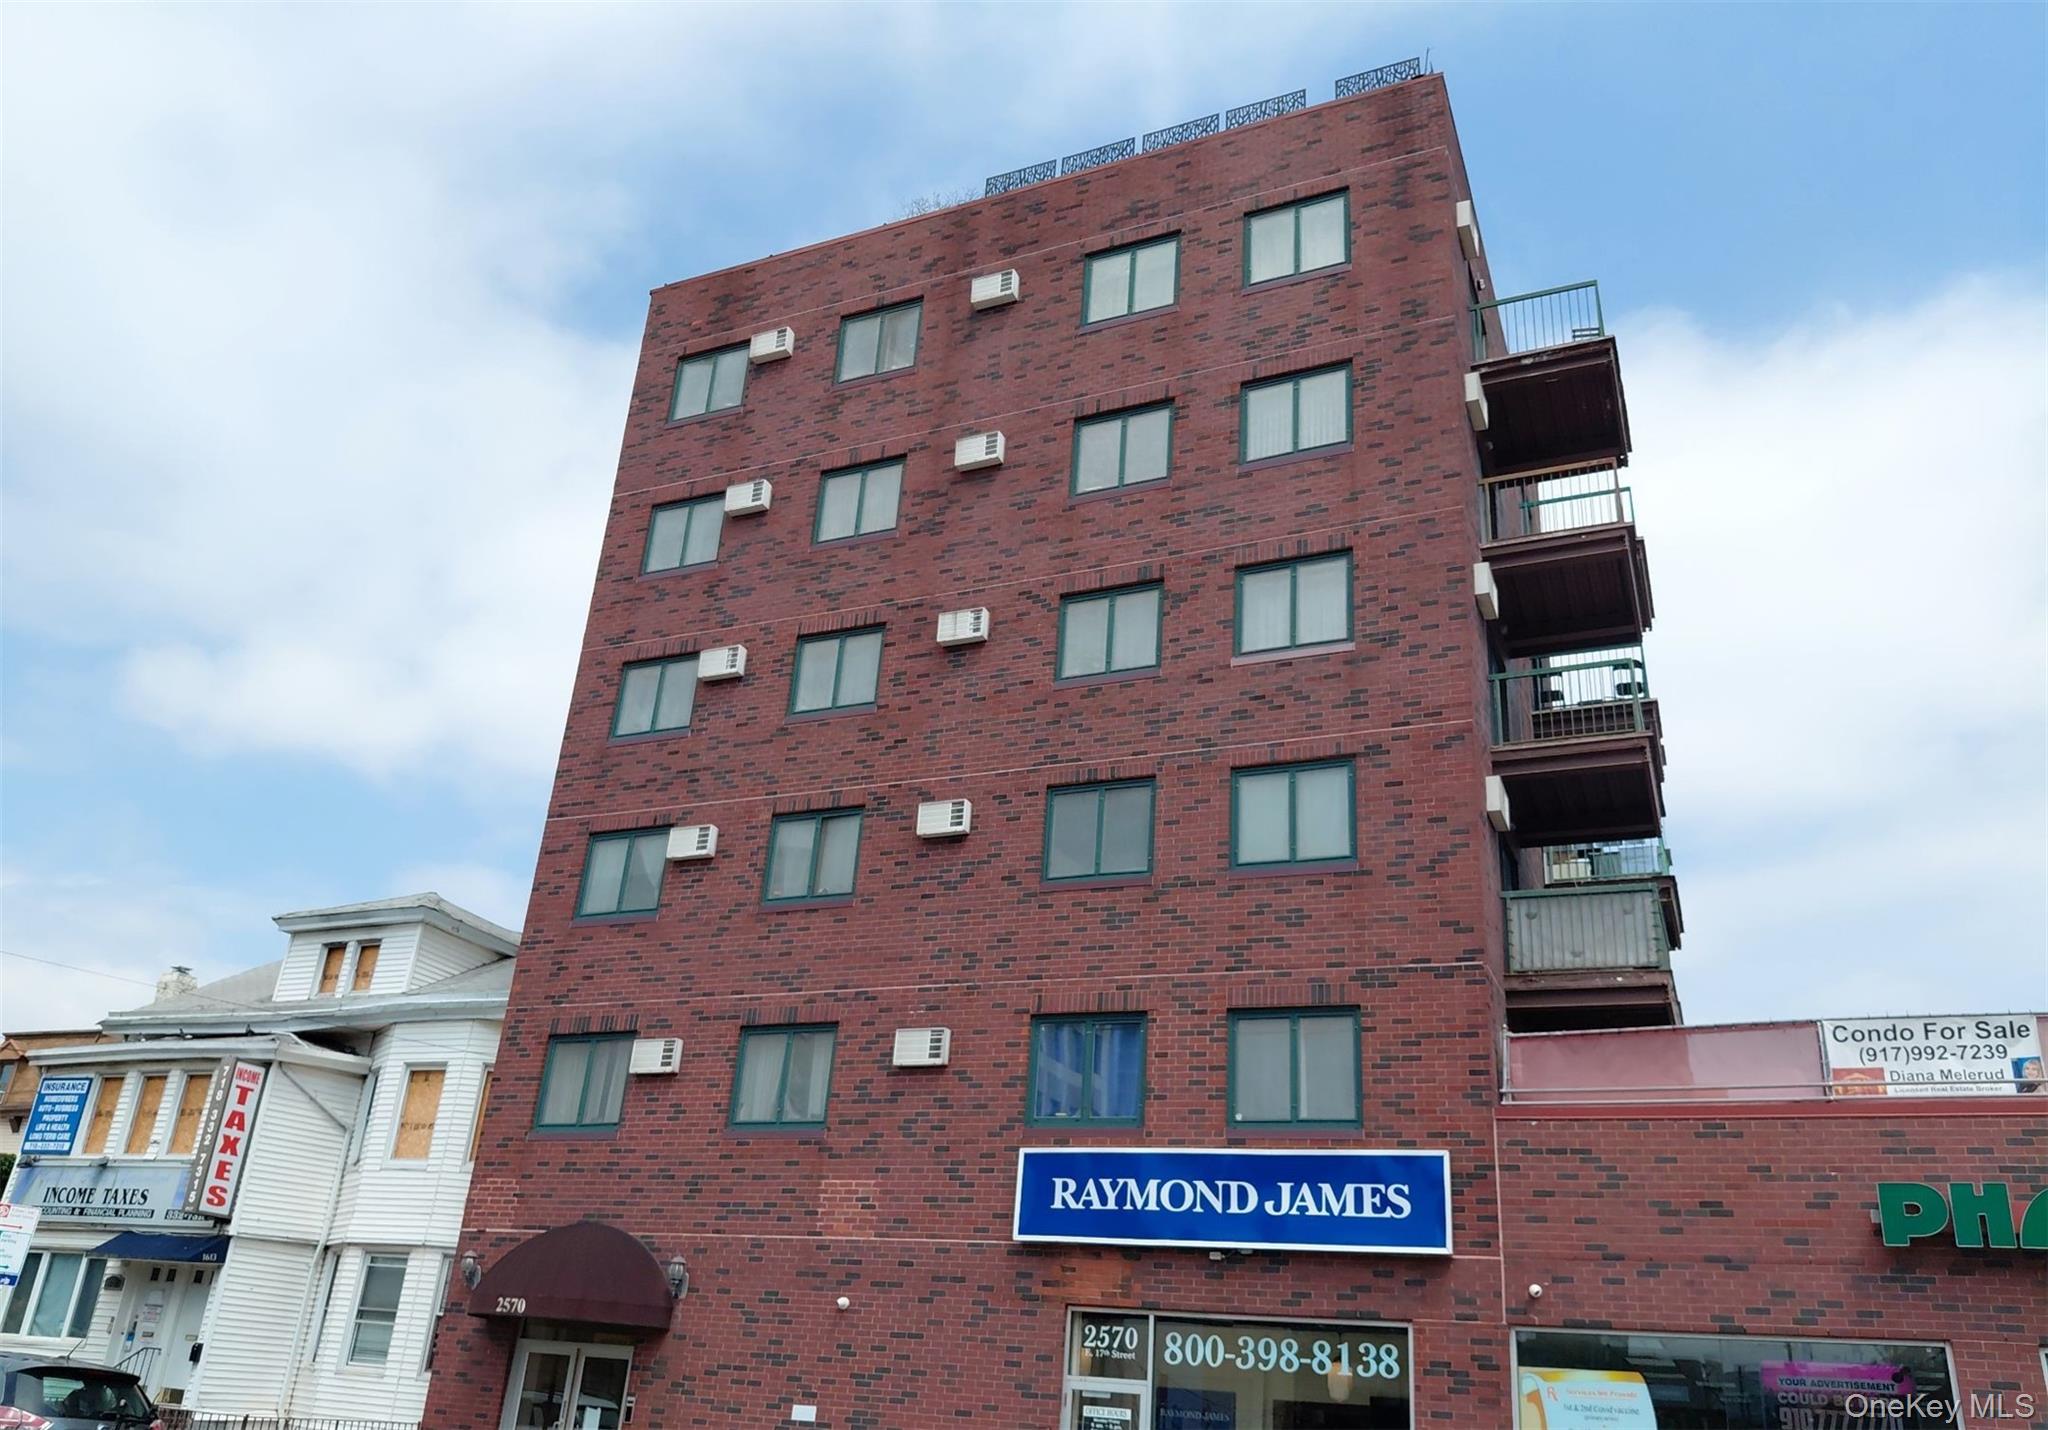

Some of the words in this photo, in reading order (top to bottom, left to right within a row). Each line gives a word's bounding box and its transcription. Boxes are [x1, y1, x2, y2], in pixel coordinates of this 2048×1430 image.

[1832, 1023, 1914, 1043] Condo
[1923, 1022, 1966, 1040] For
[1975, 1020, 2031, 1039] Sale
[1859, 1044, 2008, 1066] (917)992-7239
[215, 1065, 230, 1101] 718
[1889, 1069, 1935, 1082] Diana
[1940, 1068, 2005, 1081] Melerud
[43, 1082, 87, 1092] INSURANCE
[206, 1084, 254, 1207] TAXES
[43, 1187, 96, 1205] INCOME
[102, 1187, 150, 1206] TAXES
[1050, 1177, 1259, 1214] RAYMOND
[1264, 1181, 1412, 1219] JAMES
[83, 1207, 116, 1217] FINANCIAL
[119, 1209, 151, 1218] PLANNING
[495, 1296, 526, 1314] 2570
[1083, 1324, 1138, 1350] 2570
[1111, 1350, 1136, 1360] Street
[1163, 1331, 1401, 1380] 800-398-8138
[1778, 1376, 1807, 1387] YOUR
[1810, 1379, 1896, 1392] ADVERTISEMENT
[1777, 1392, 1828, 1406] COULD
